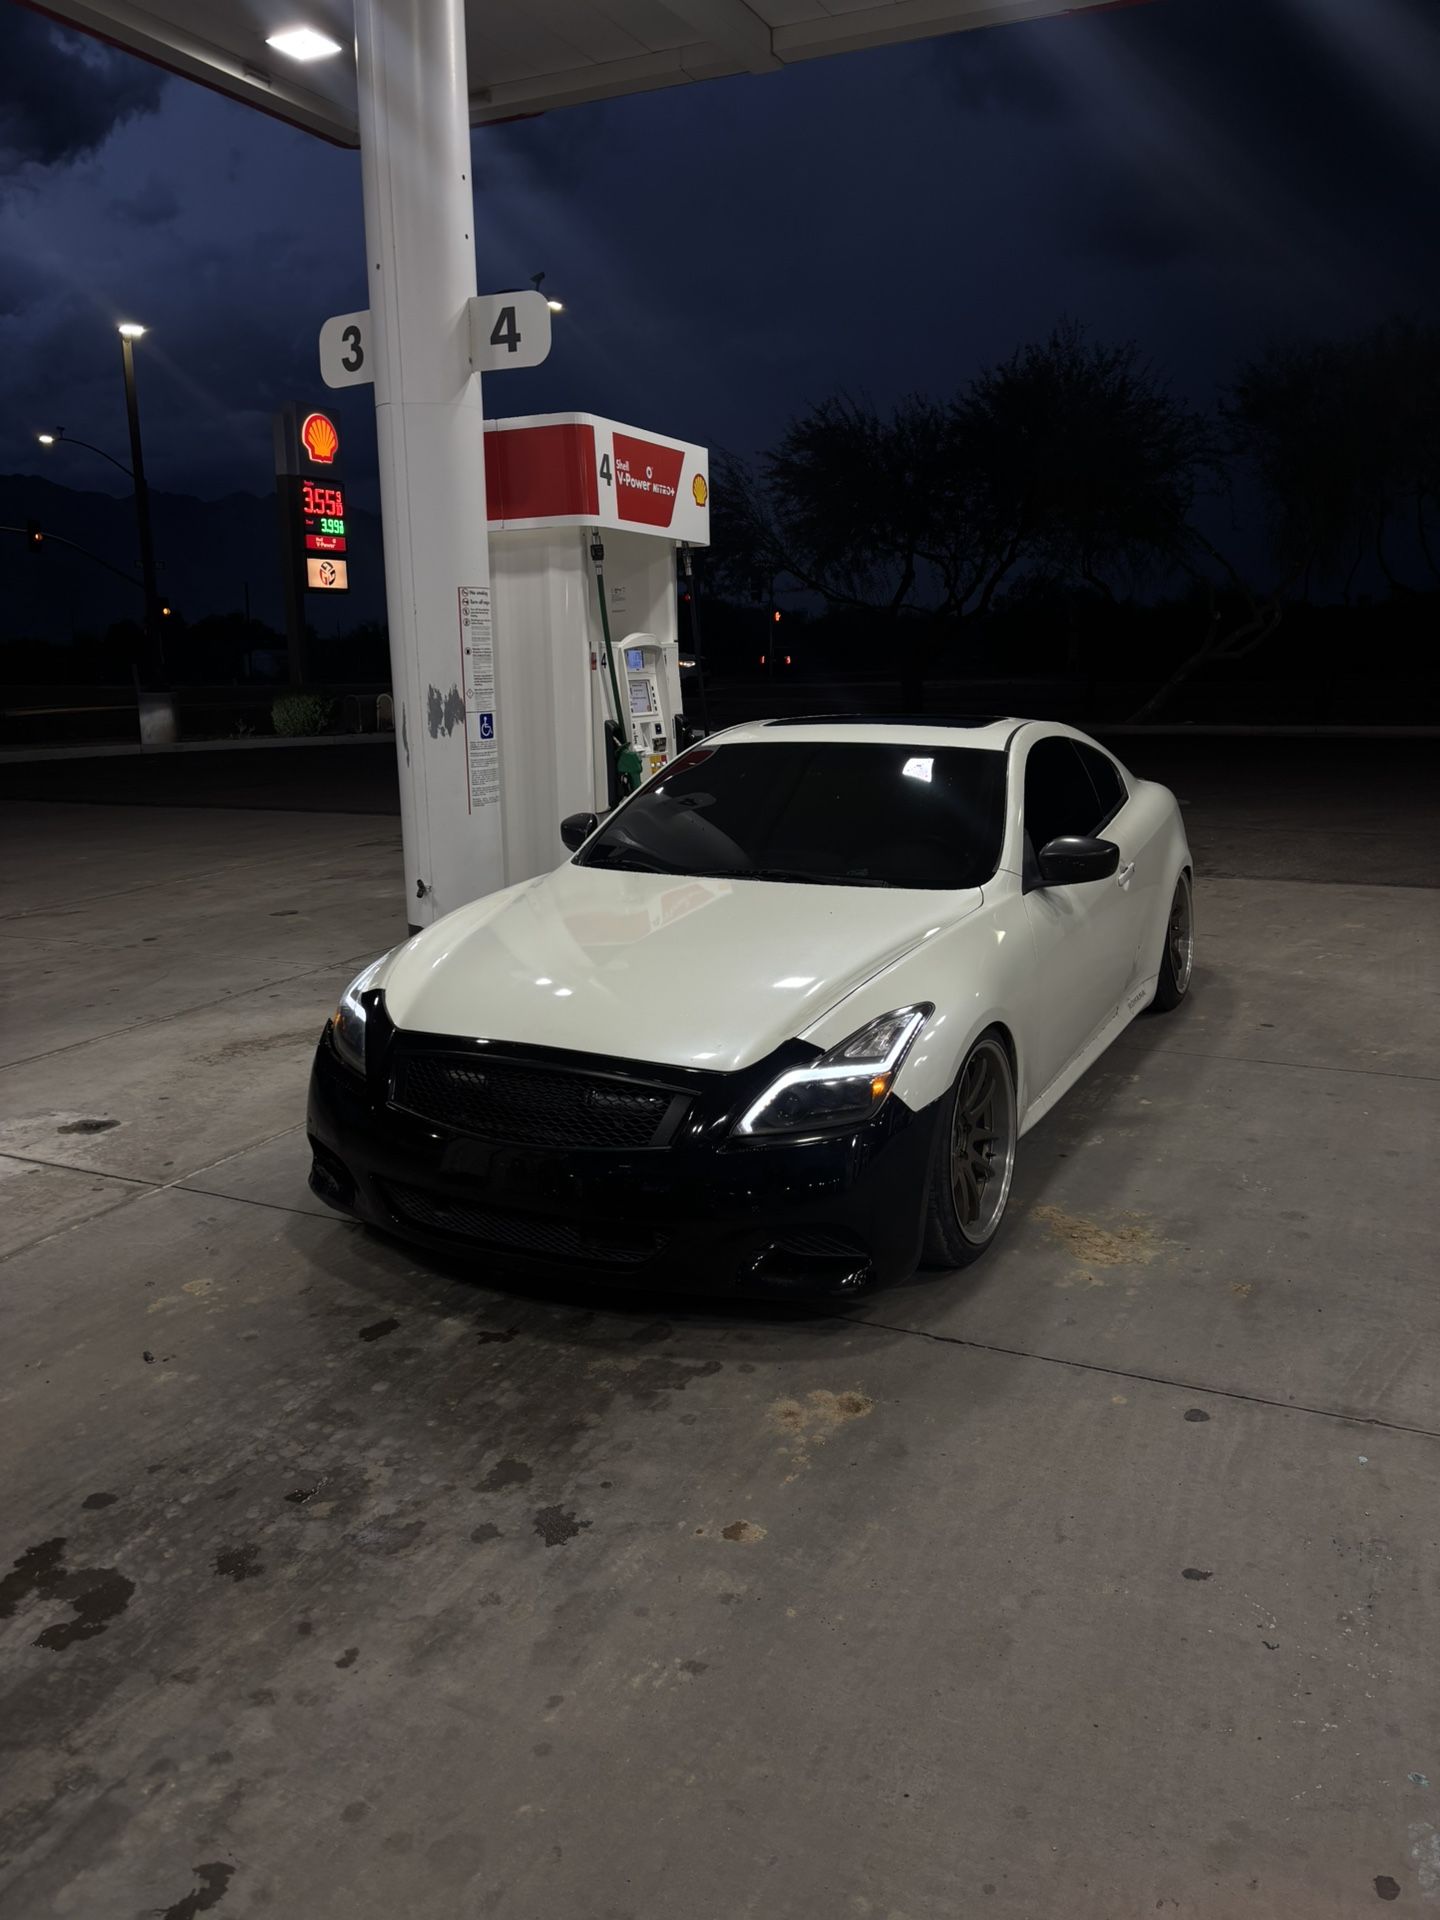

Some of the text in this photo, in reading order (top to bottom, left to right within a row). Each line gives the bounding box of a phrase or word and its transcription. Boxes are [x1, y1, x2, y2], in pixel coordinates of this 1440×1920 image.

[490, 306, 521, 353] 4
[341, 325, 365, 373] 3
[599, 453, 613, 487] 4
[616, 458, 630, 472] Shell
[616, 470, 652, 492] V-Power
[601, 652, 607, 669] 4
